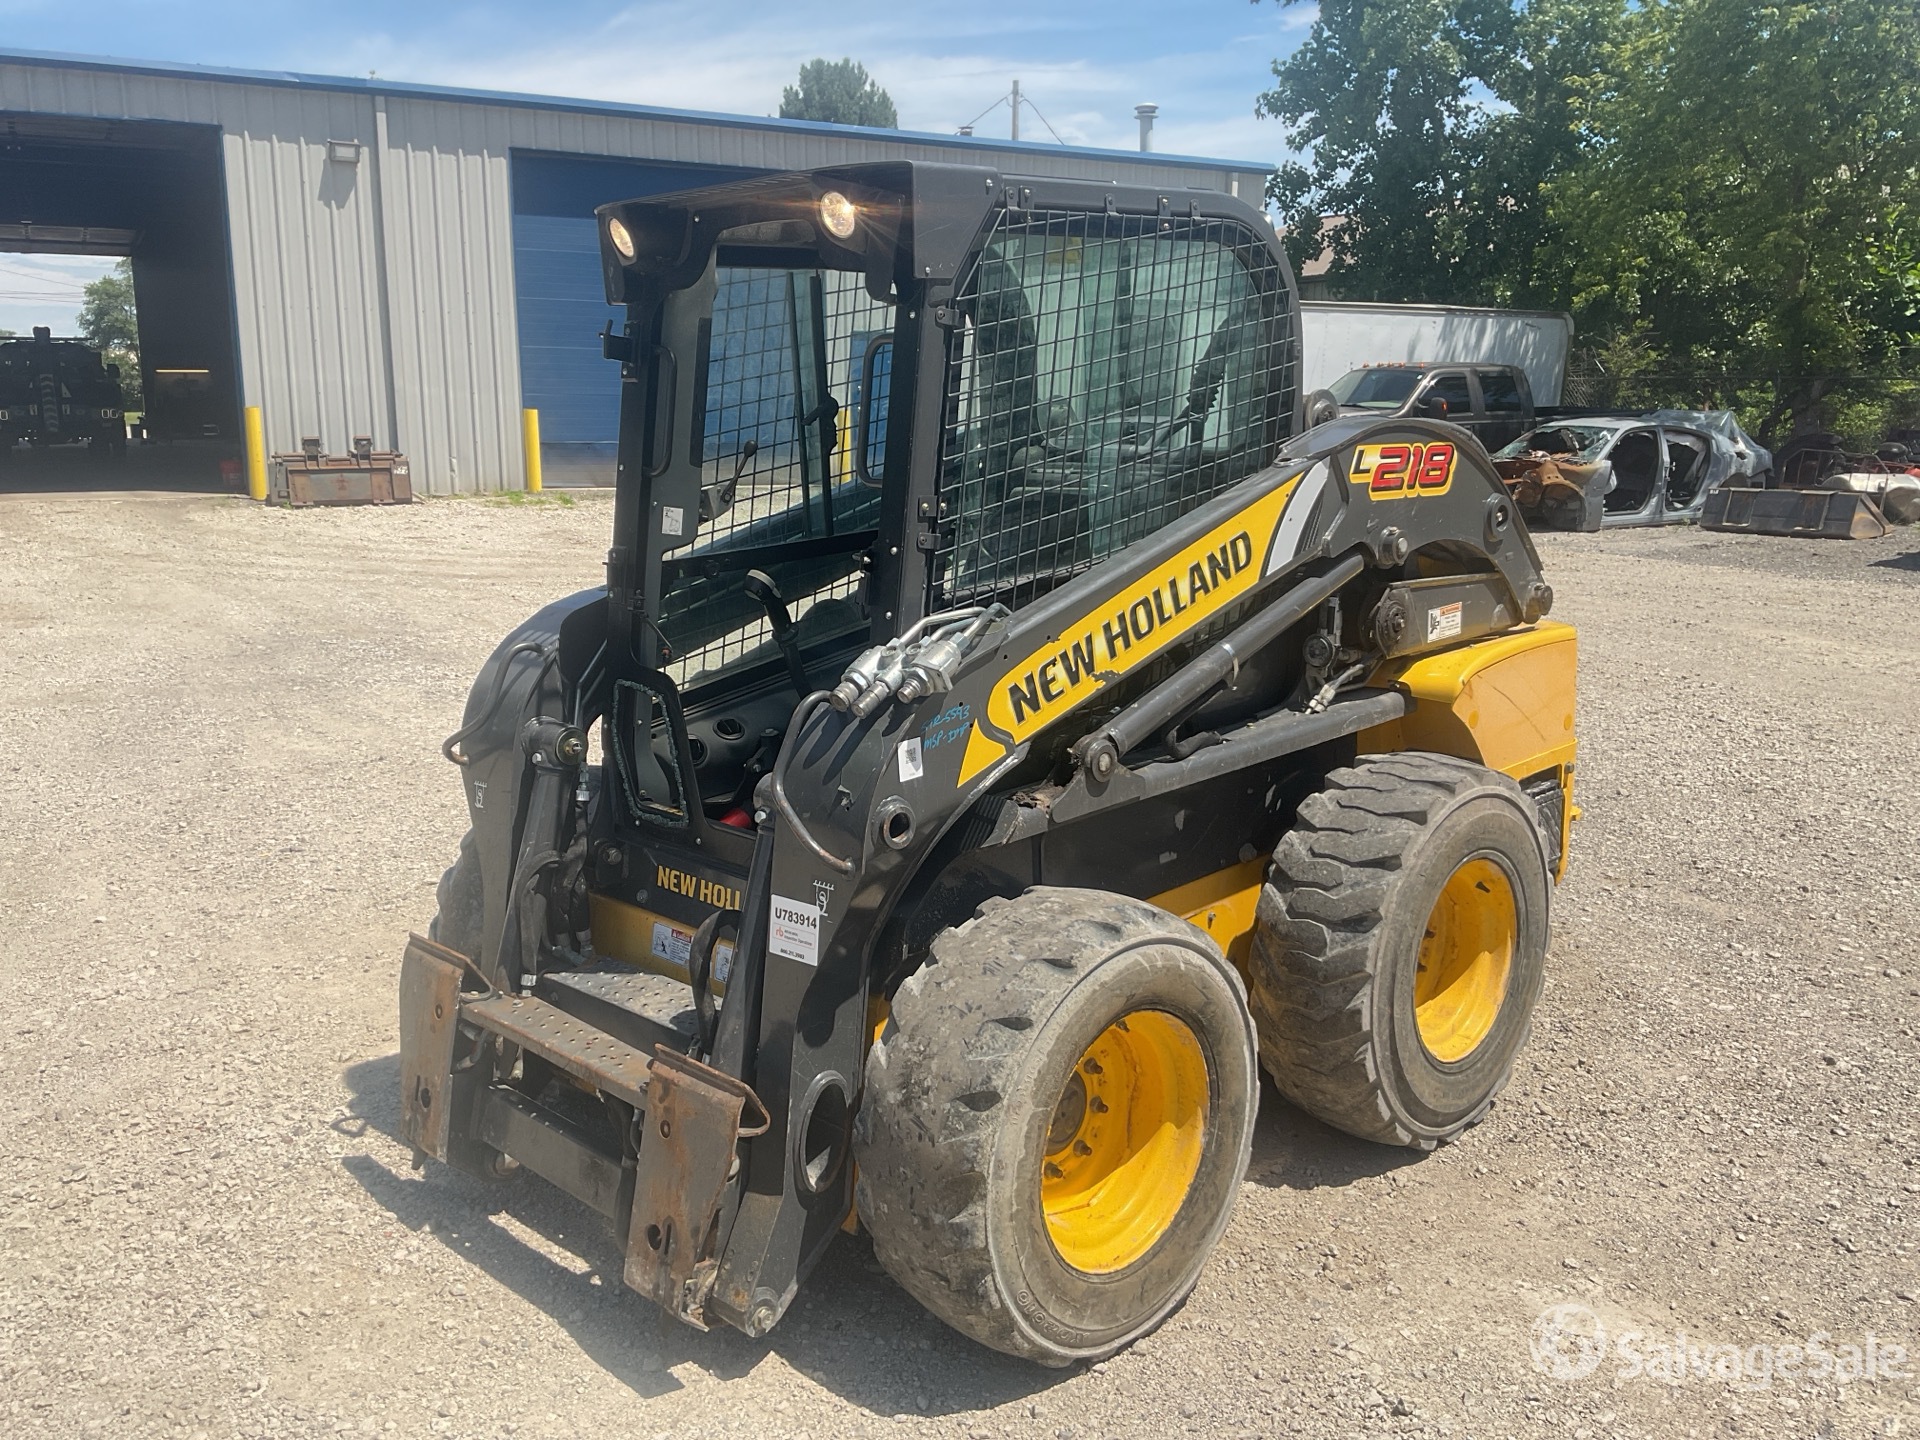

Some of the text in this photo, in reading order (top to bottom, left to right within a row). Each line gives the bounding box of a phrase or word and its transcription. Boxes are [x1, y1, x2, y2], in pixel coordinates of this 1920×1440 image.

[1350, 442, 1457, 499] L218
[1007, 530, 1253, 726] NEW HOLLAND
[657, 865, 697, 898] NEW
[775, 907, 817, 929] U783914
